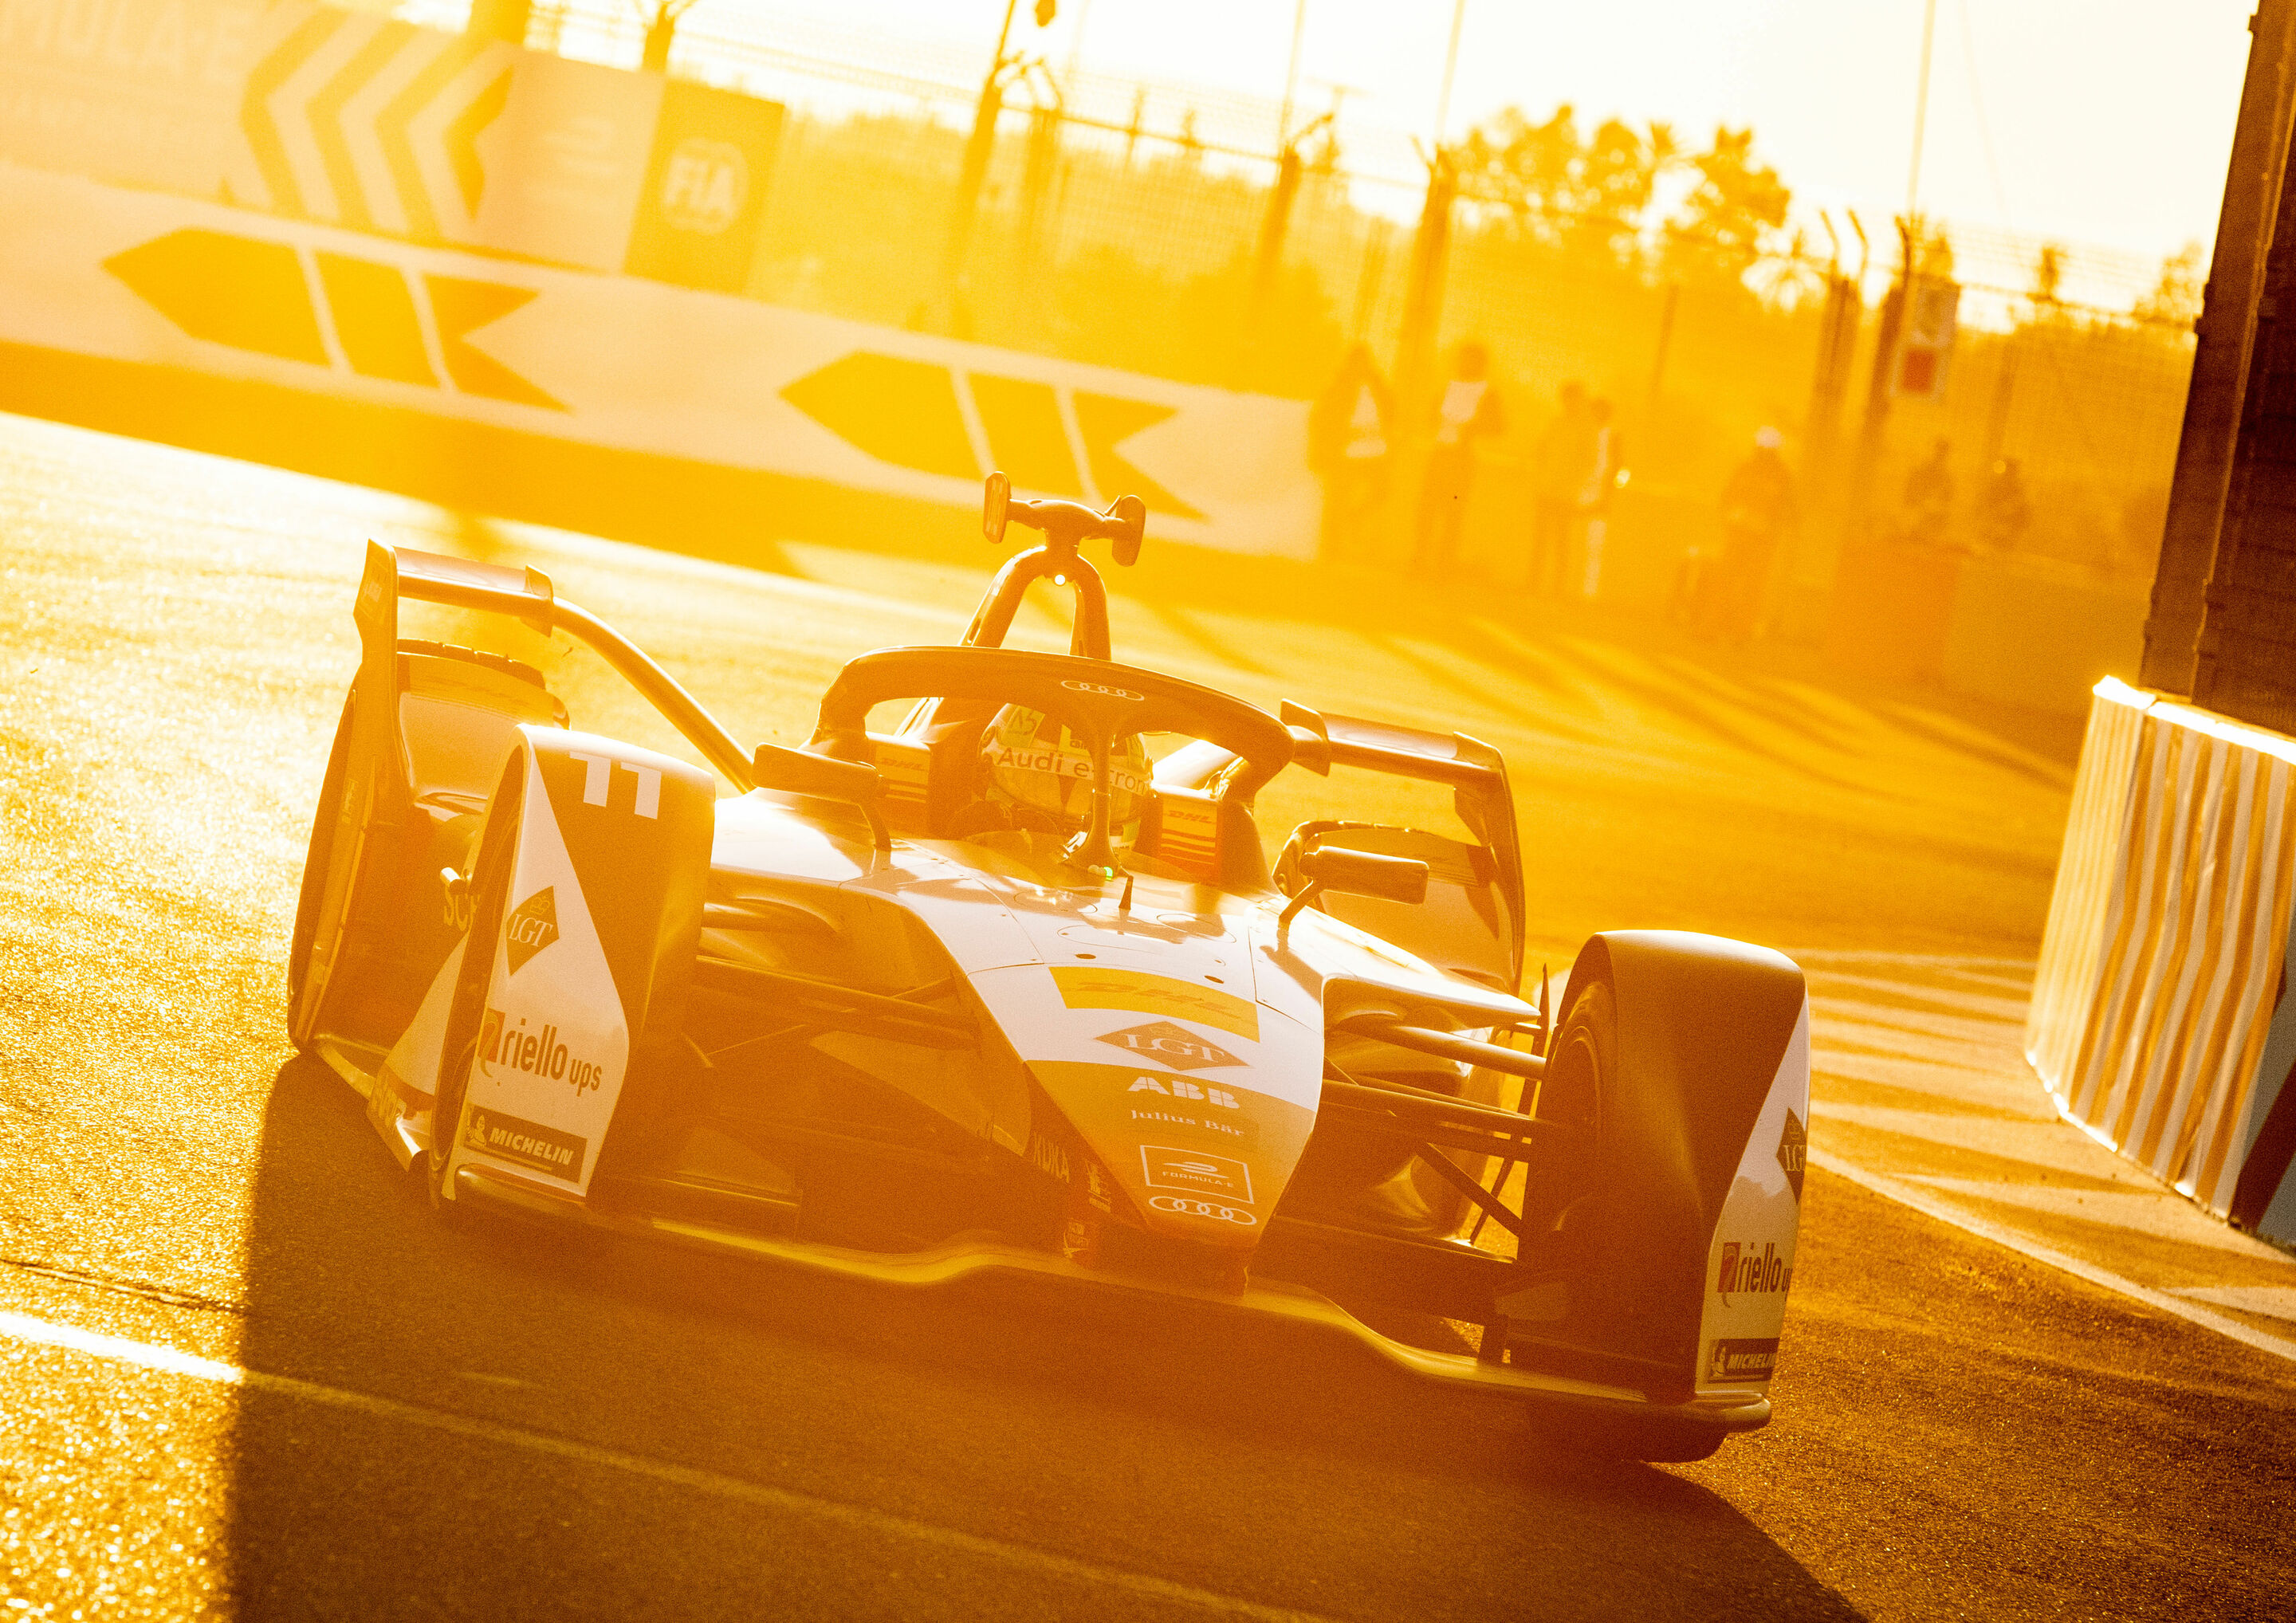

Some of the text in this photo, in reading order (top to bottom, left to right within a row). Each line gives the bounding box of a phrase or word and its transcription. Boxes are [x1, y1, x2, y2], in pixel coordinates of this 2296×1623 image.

[880, 756, 925, 772] DHL
[997, 748, 1064, 773] Audi
[569, 751, 661, 820] 11
[1168, 809, 1212, 823] DHL
[508, 913, 553, 947] LGT
[500, 1017, 603, 1098] riello ups
[1122, 1034, 1224, 1063] LGT
[1126, 1076, 1240, 1110] ABB
[1130, 1109, 1246, 1137] Julius Bär
[489, 1128, 574, 1166] MICHELIN
[1737, 1242, 1782, 1293] riello
